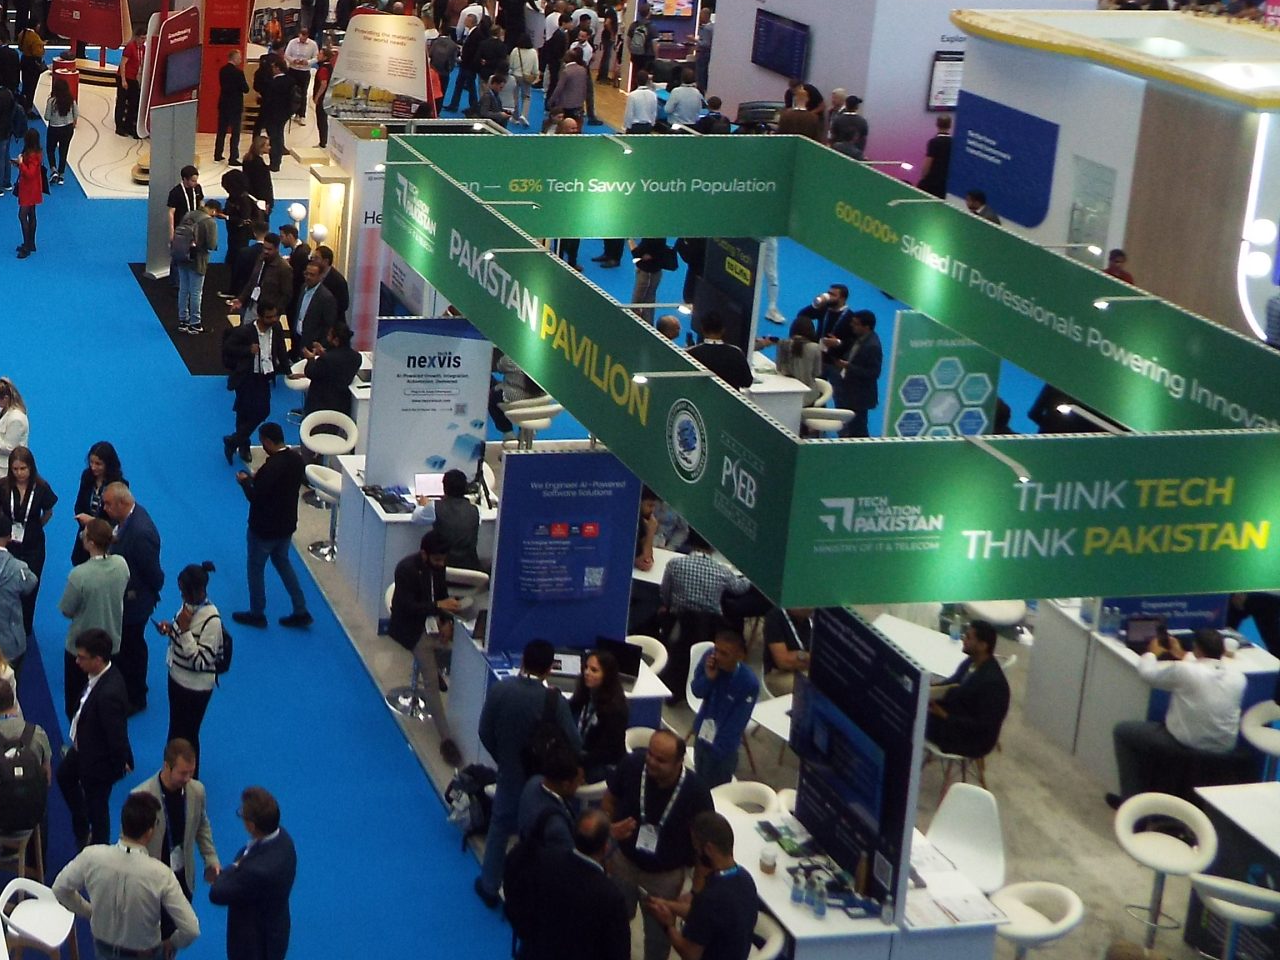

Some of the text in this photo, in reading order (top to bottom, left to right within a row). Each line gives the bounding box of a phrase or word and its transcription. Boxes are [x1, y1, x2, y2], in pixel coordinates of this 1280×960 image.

[508, 178, 776, 196] 63% Tech Savvy Youth Population
[835, 200, 899, 246] 600,000+
[900, 233, 951, 272] Skilled
[952, 257, 966, 283] IT
[968, 269, 1083, 343] Professionals
[1086, 326, 1187, 400] Powering
[448, 228, 651, 427] PAKISTAN PAVILION
[407, 352, 461, 369] nexvis
[545, 481, 577, 490] Engineer
[1014, 477, 1234, 512] THINK TECH
[858, 496, 887, 507] TECH
[853, 514, 943, 533] PAKISTAN
[962, 521, 1270, 559] THINK PAKISTAN
